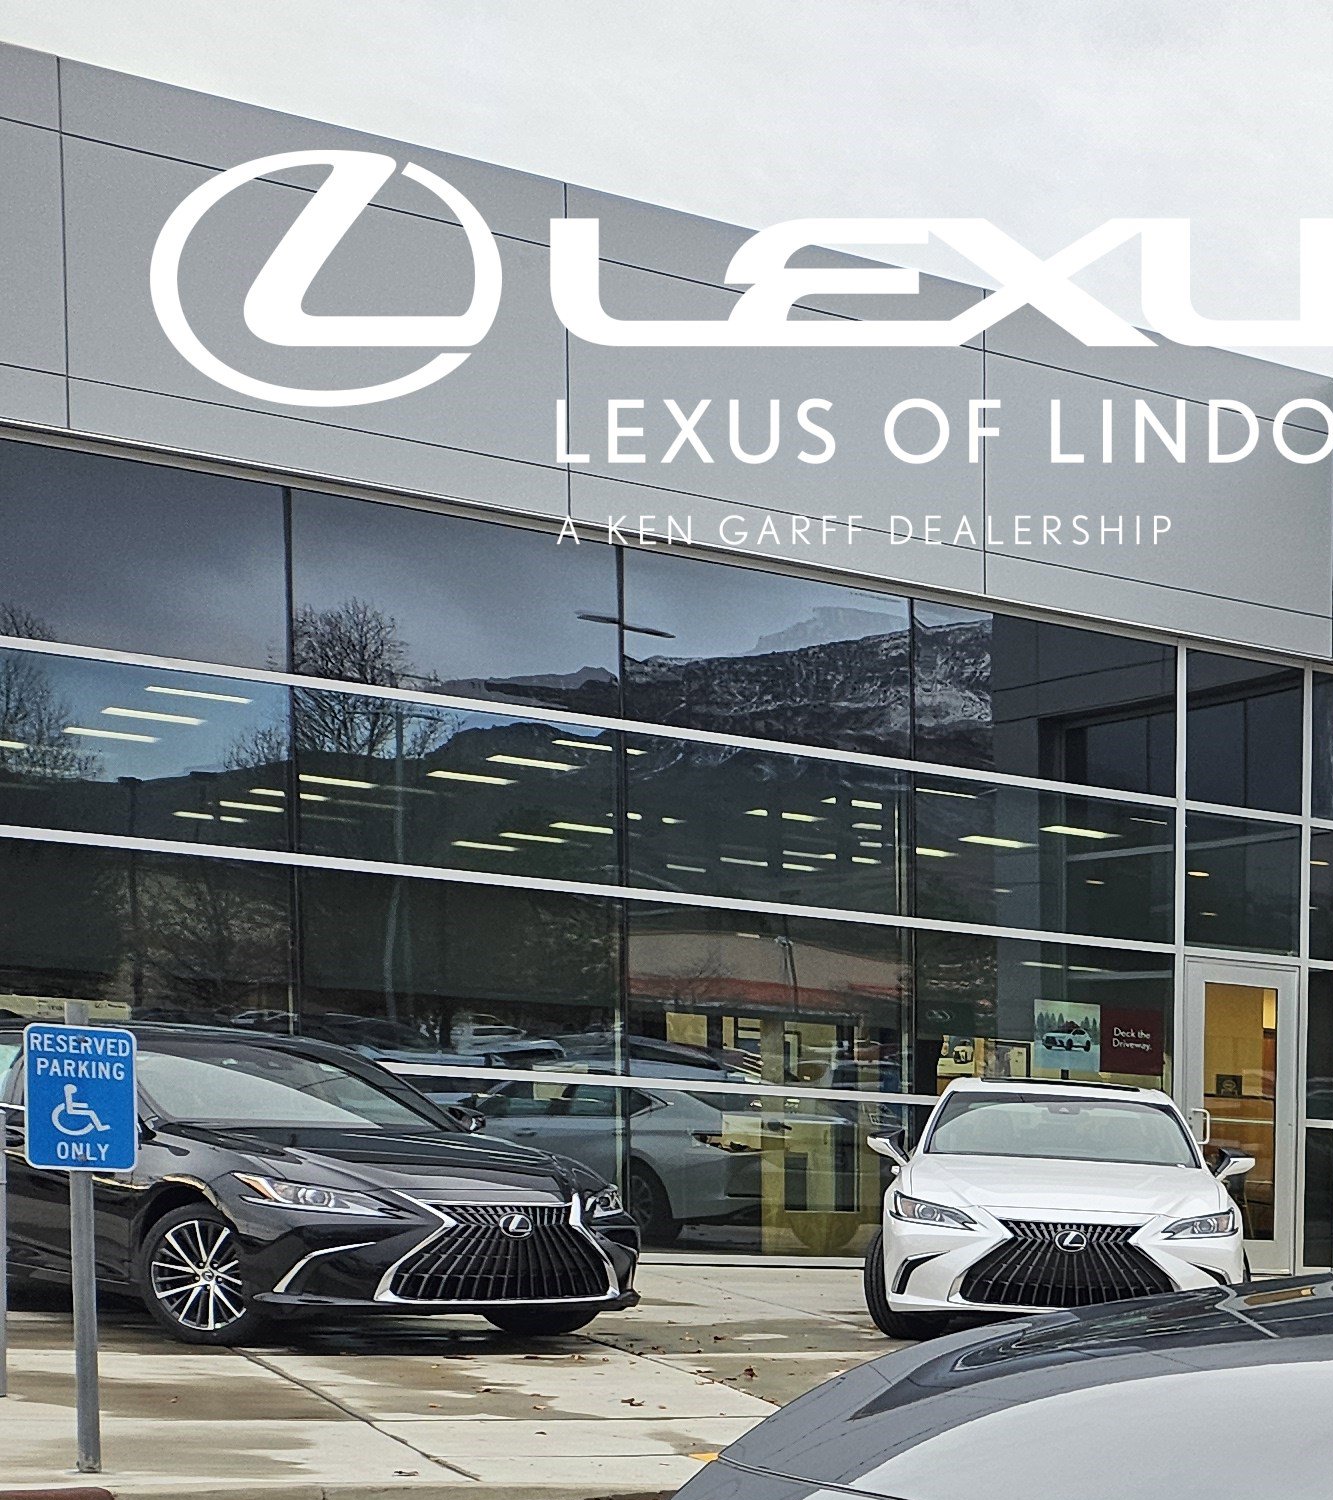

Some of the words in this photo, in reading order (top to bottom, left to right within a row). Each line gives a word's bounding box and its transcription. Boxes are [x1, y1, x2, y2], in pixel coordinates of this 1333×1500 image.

[1113, 1026, 1136, 1038] Deck
[1137, 1029, 1151, 1039] the
[29, 1032, 130, 1057] RESERVED
[36, 1057, 125, 1081] PARKING
[56, 1141, 110, 1162] ONLY
